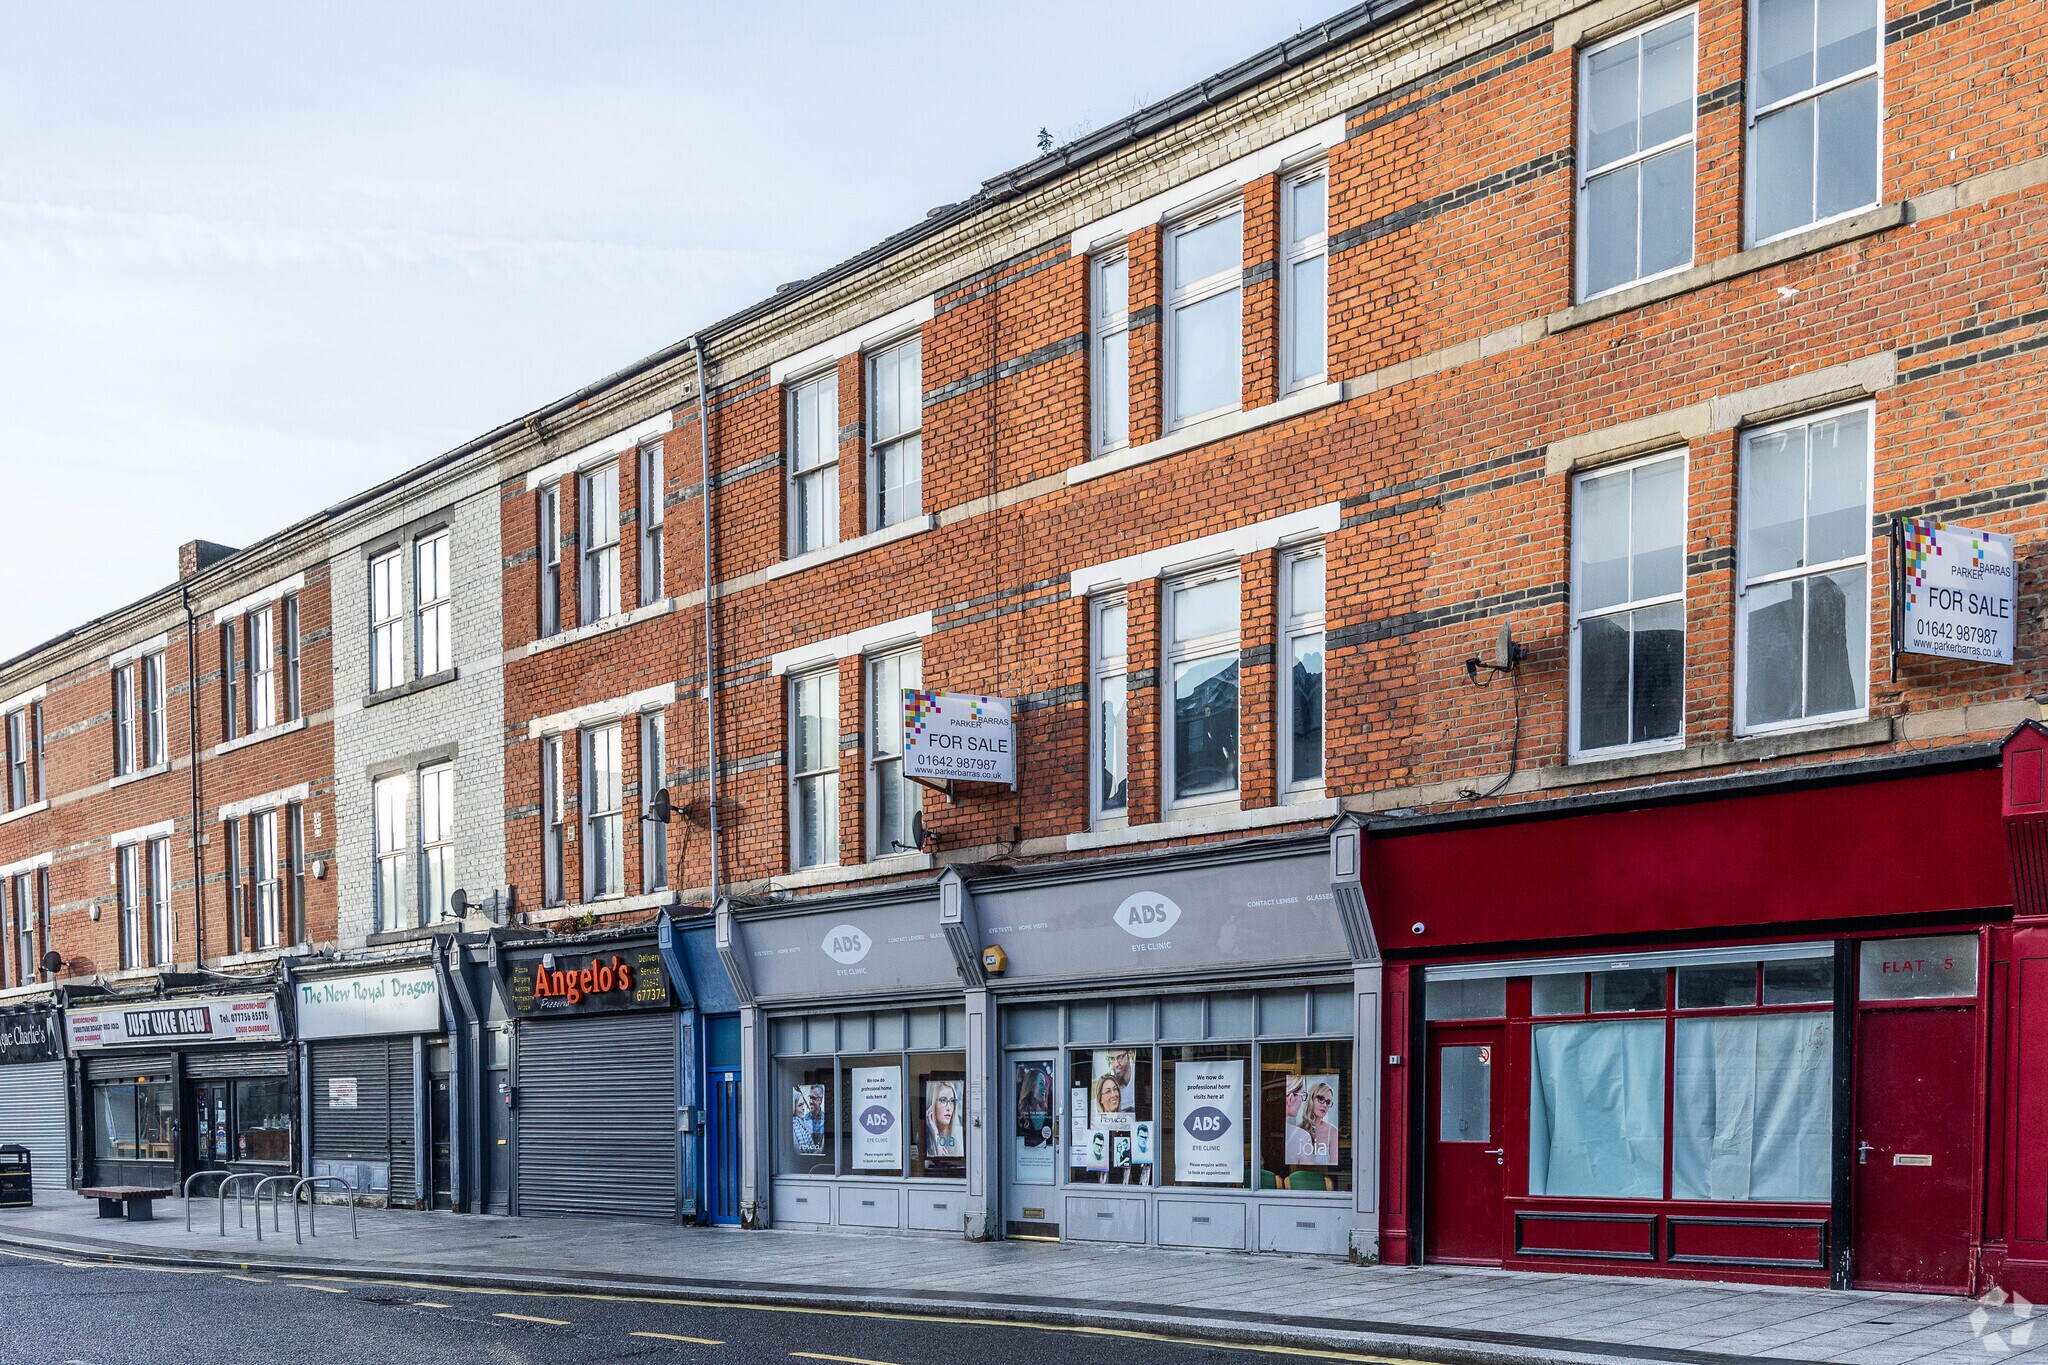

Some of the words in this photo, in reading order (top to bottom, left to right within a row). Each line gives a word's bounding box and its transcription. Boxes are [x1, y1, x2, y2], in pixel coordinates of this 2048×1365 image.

[1951, 566, 1984, 580] PARKER
[1980, 562, 2010, 578] BARRAS
[1930, 587, 1963, 612] FOR
[1968, 593, 2009, 618] SALE
[1917, 619, 1952, 640] 01642
[1956, 625, 1998, 644] 987987
[1913, 639, 2002, 658] www.parkerbarras.co.uk
[950, 719, 982, 728] PARKER
[978, 716, 1009, 726] BARRAS
[929, 734, 962, 750] FOR
[968, 737, 1008, 753] SALE
[918, 754, 952, 768] 01642
[956, 758, 996, 770] 987987
[914, 767, 1002, 778] www.parkerbarras.co.uk
[1247, 899, 1274, 908] CONTACT
[1276, 896, 1298, 904] LENSES
[1306, 892, 1334, 902] GLASSES
[1128, 903, 1166, 926] ADS
[833, 935, 862, 953] ADS
[1147, 942, 1172, 950] CLINIC
[640, 966, 660, 976] Service
[1882, 960, 1924, 973] FLAT
[1944, 958, 1953, 970] 5
[534, 956, 630, 1004] Angelo's
[302, 986, 322, 1004] The
[324, 984, 350, 1003] New
[352, 978, 385, 1004] Royal
[391, 978, 435, 1000] Dragon
[636, 988, 666, 1002] 677374
[127, 1014, 150, 1036] JUST
[152, 1011, 178, 1034] LIKE
[14, 1024, 46, 1045] Charlie's
[866, 1113, 888, 1126] ADS
[1192, 1116, 1220, 1131] ADS
